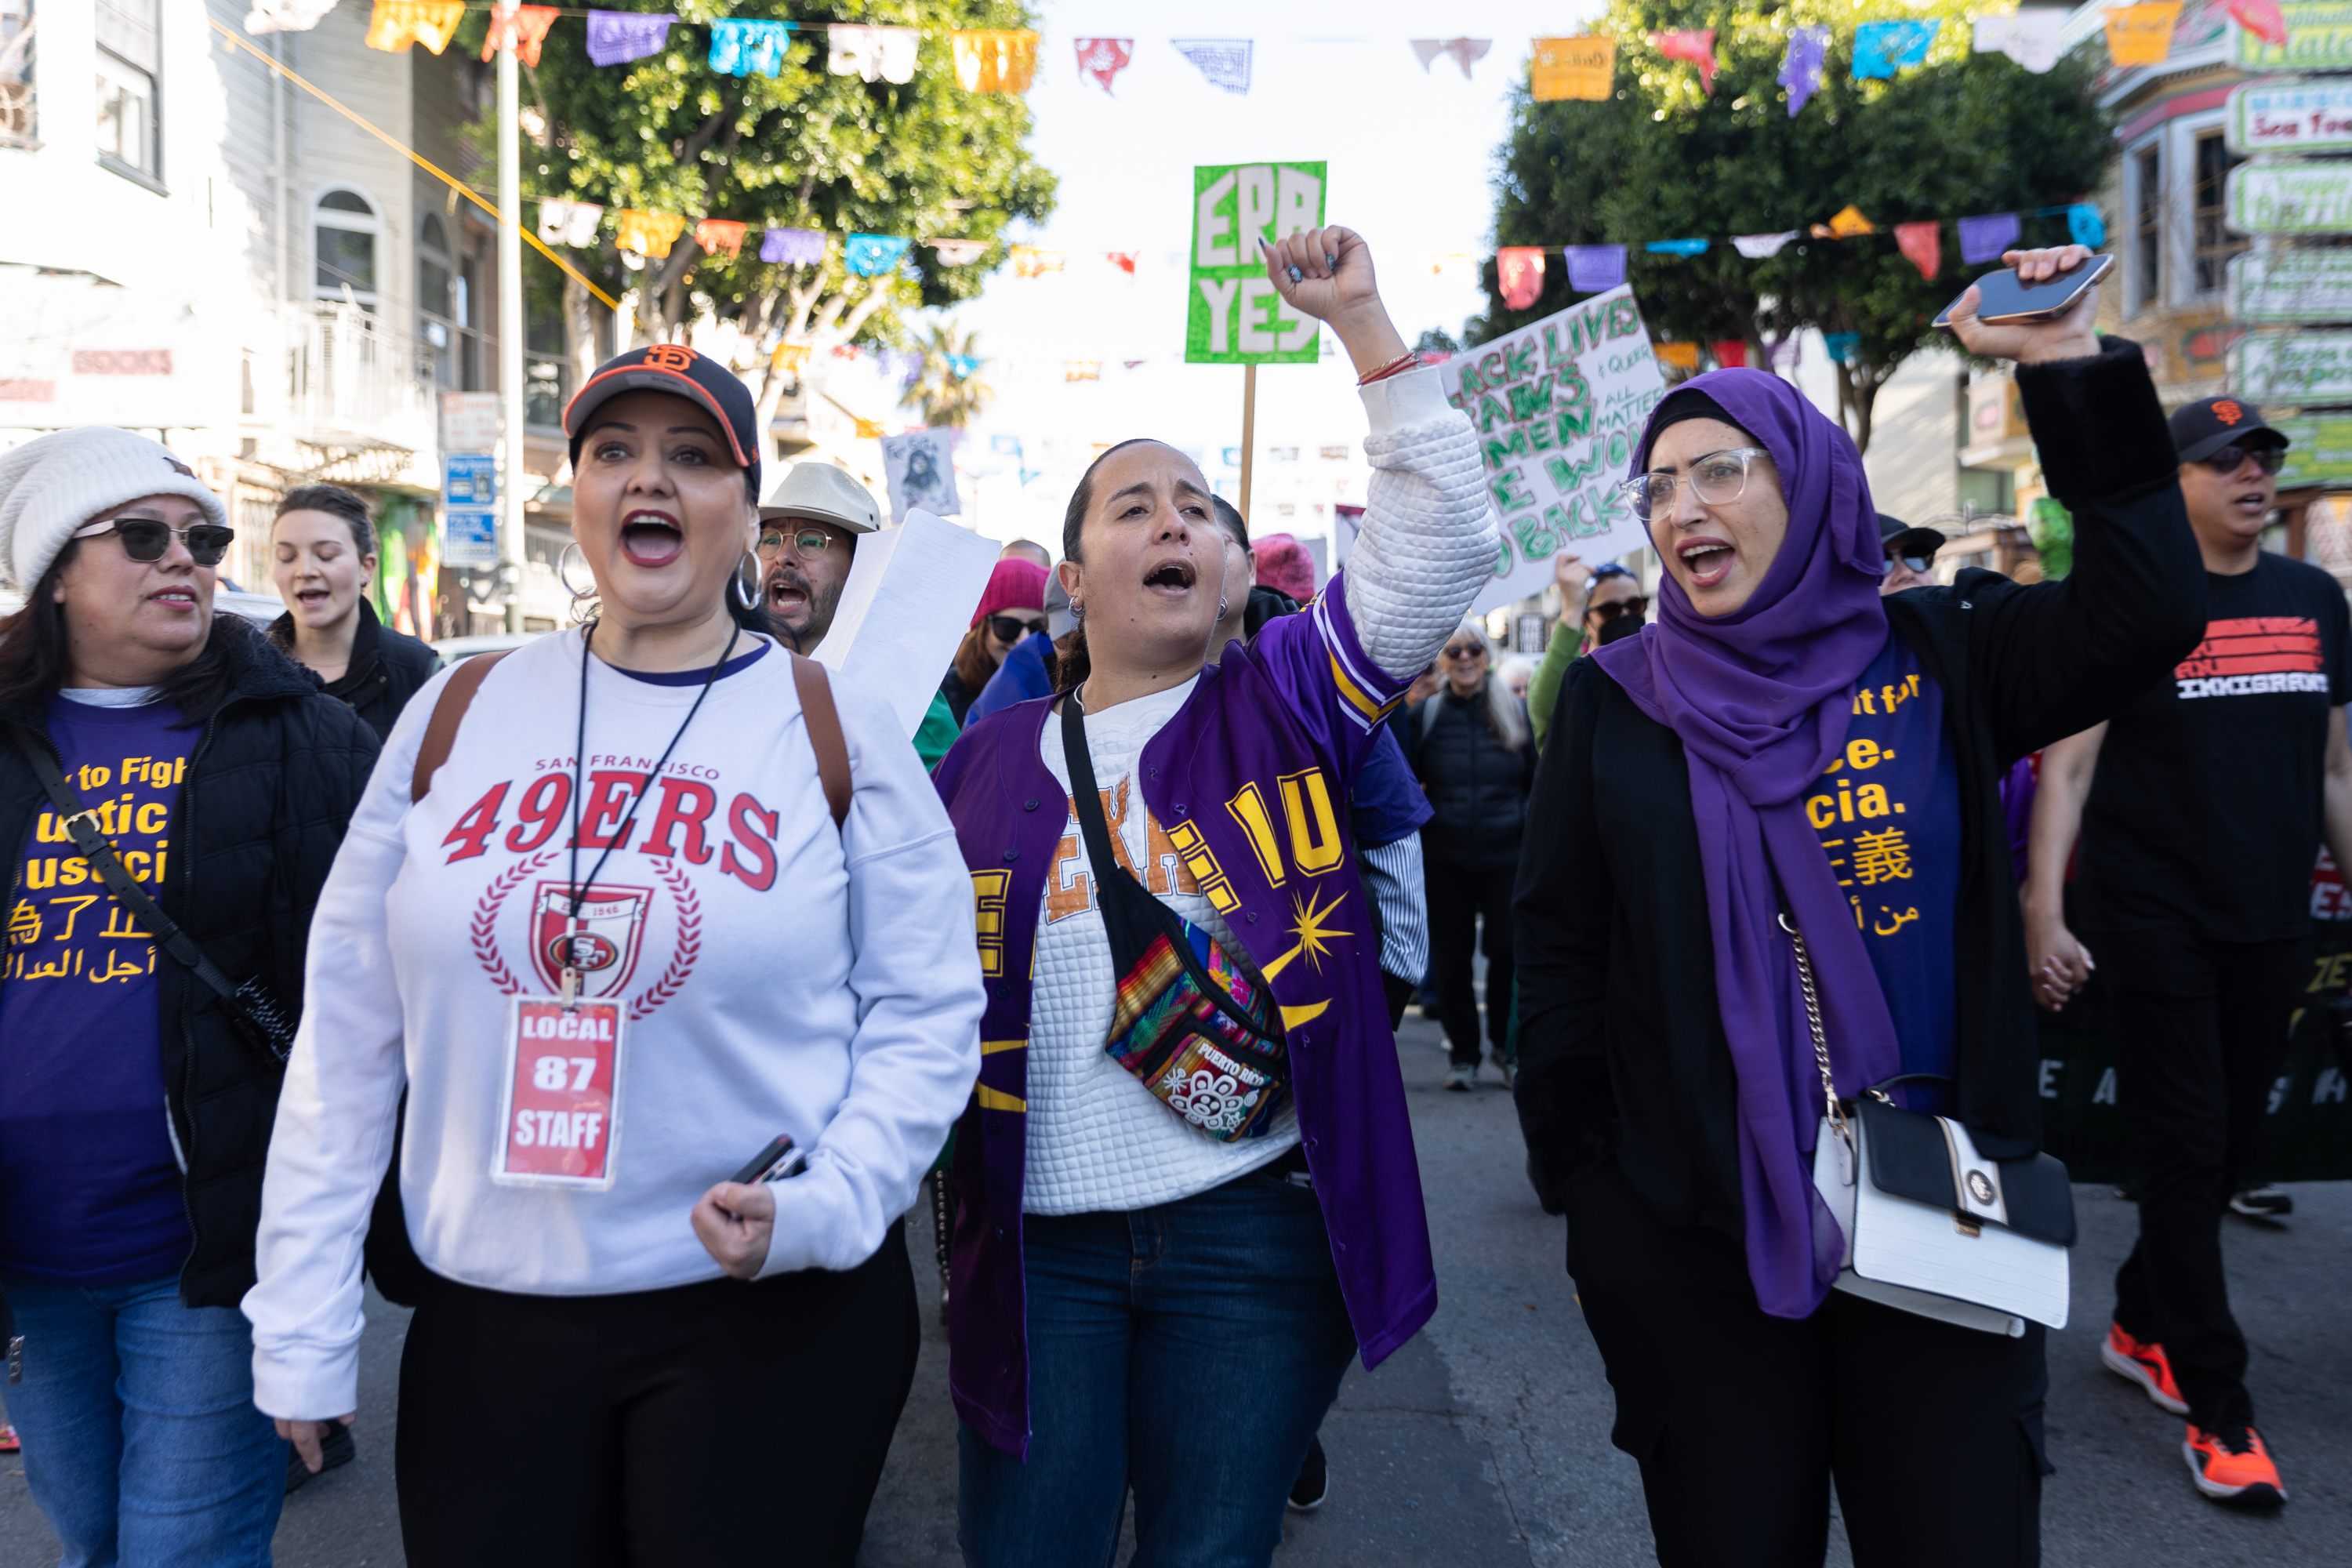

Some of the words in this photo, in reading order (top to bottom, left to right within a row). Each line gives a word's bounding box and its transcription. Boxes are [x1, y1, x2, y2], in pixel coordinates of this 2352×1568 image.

[1197, 165, 1321, 268] ERA
[1541, 293, 1642, 371] LIVES
[1607, 343, 1653, 375] QUEER
[1605, 384, 1635, 408] ALL
[1508, 480, 1632, 563] BACK
[1880, 674, 1920, 713] for
[78, 764, 111, 791] to
[440, 771, 780, 892] 49ERS
[522, 1015, 613, 1042] LOCAL
[533, 1056, 597, 1092] 87
[1197, 1043, 1240, 1076] PUERTO
[515, 1109, 602, 1149] STAFF
